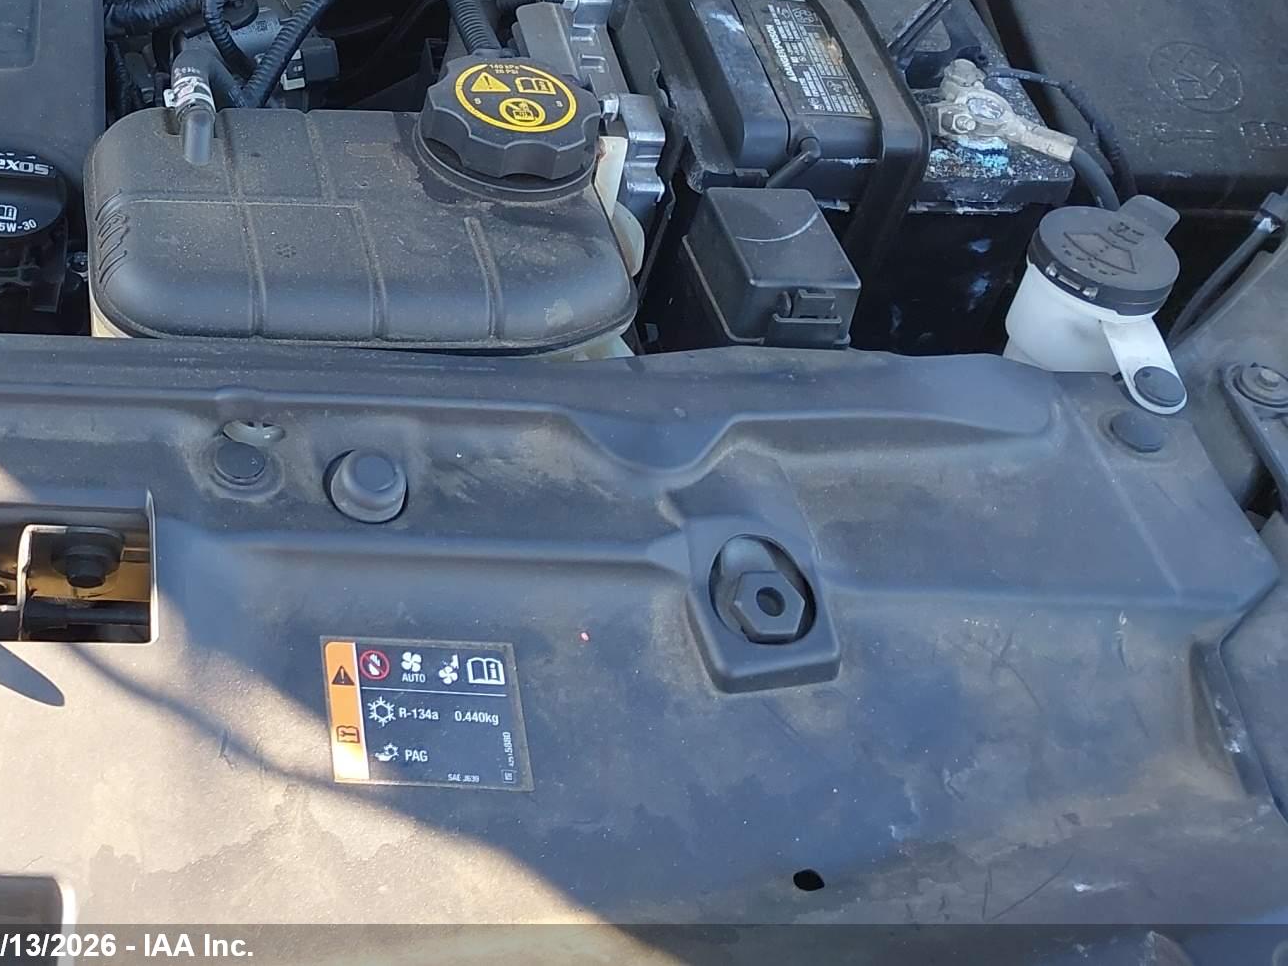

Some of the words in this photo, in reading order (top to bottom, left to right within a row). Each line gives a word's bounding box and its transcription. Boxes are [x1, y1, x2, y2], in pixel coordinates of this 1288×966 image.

[402, 673, 426, 683] AUTO
[399, 708, 440, 721] R-134a
[454, 710, 500, 726] 0.440kg
[404, 749, 429, 763] PAG
